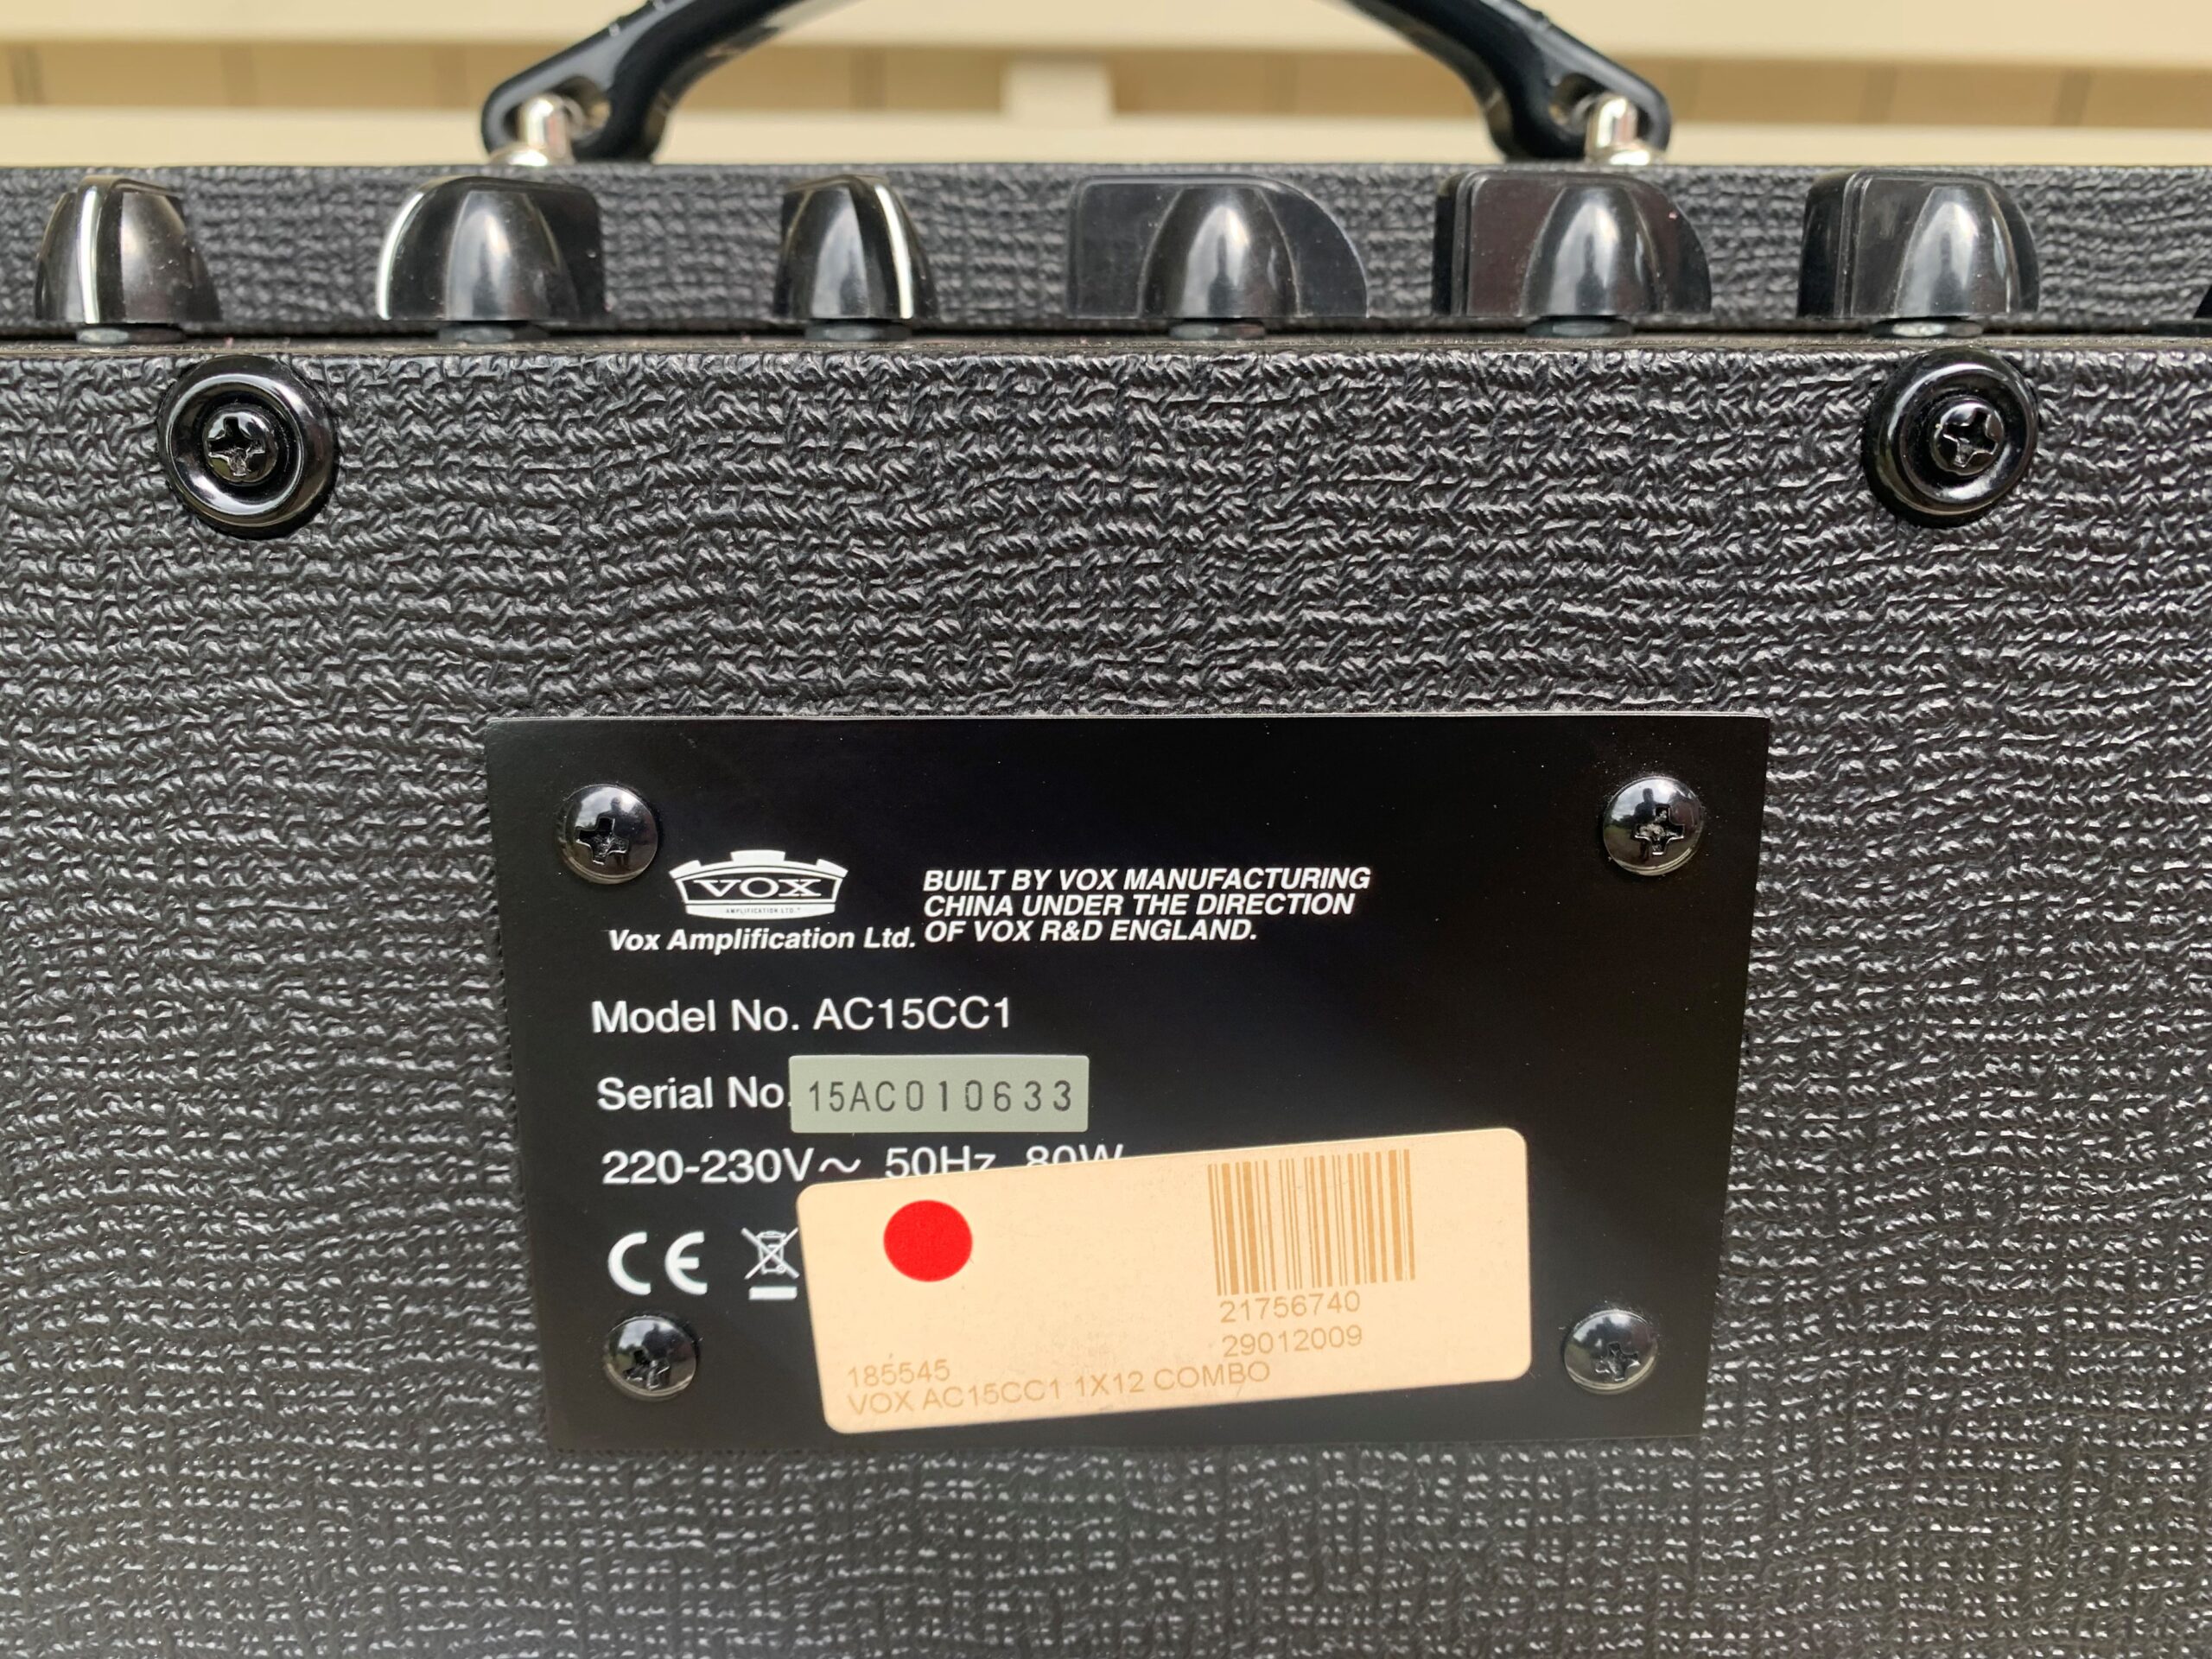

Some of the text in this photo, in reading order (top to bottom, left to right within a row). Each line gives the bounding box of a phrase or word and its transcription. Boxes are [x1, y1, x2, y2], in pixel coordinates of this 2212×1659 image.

[693, 875, 822, 898] VOX
[923, 867, 1372, 892] BUILT BY VOX MANUFACTURING
[923, 892, 1357, 918] CHINA UNDER THE DIRECTION
[608, 926, 916, 955] Vox Amplification Ltd.
[924, 918, 1258, 944] OF VOX R&D ENGLAND.
[590, 995, 1012, 1034] Model No. AC15CC1
[597, 1076, 715, 1112] Serial
[809, 1078, 1073, 1113] 15AC010633
[884, 1145, 996, 1179] 50Hz
[1219, 1289, 1362, 1325] 21756740
[1222, 1324, 1363, 1359] 29012009
[846, 1357, 952, 1390] 185545
[847, 1360, 1271, 1416] VOX AC15CC1 1X12 COMBO
